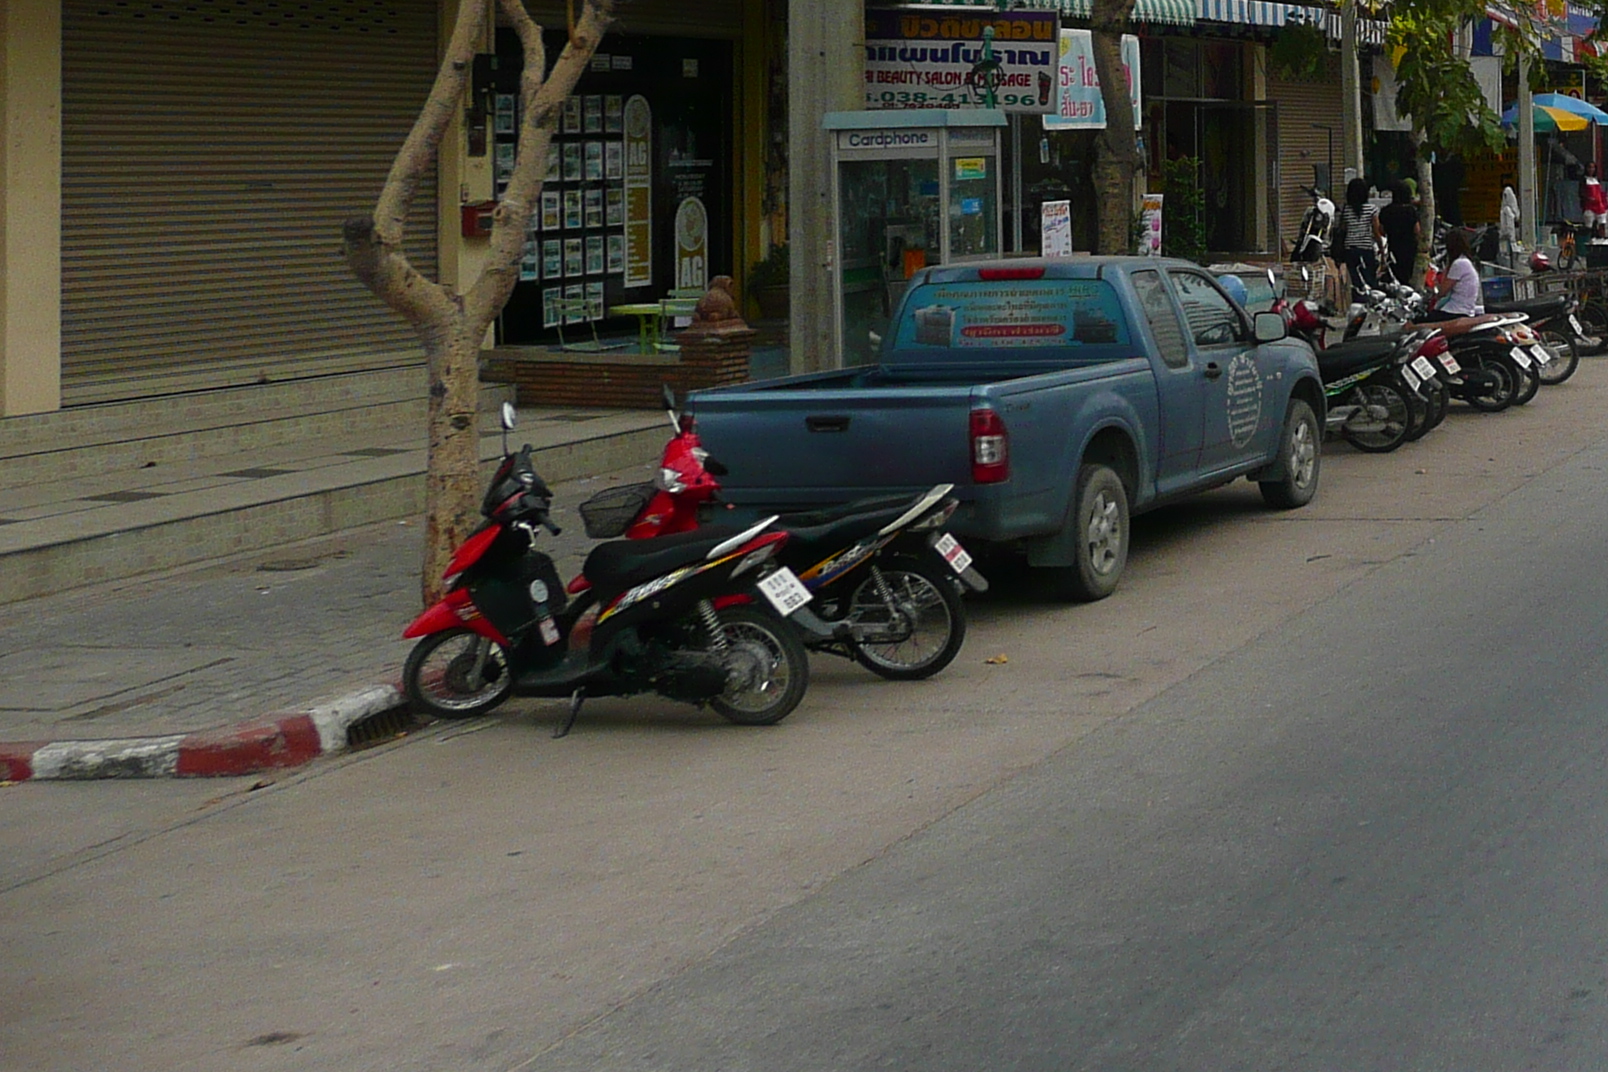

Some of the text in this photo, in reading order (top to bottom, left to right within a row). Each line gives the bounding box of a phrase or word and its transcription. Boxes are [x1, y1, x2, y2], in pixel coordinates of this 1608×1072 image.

[877, 70, 923, 86] BEAUTY
[925, 71, 962, 86] SALON
[977, 72, 1031, 87] MSSAGE
[849, 132, 929, 149] Cardphone
